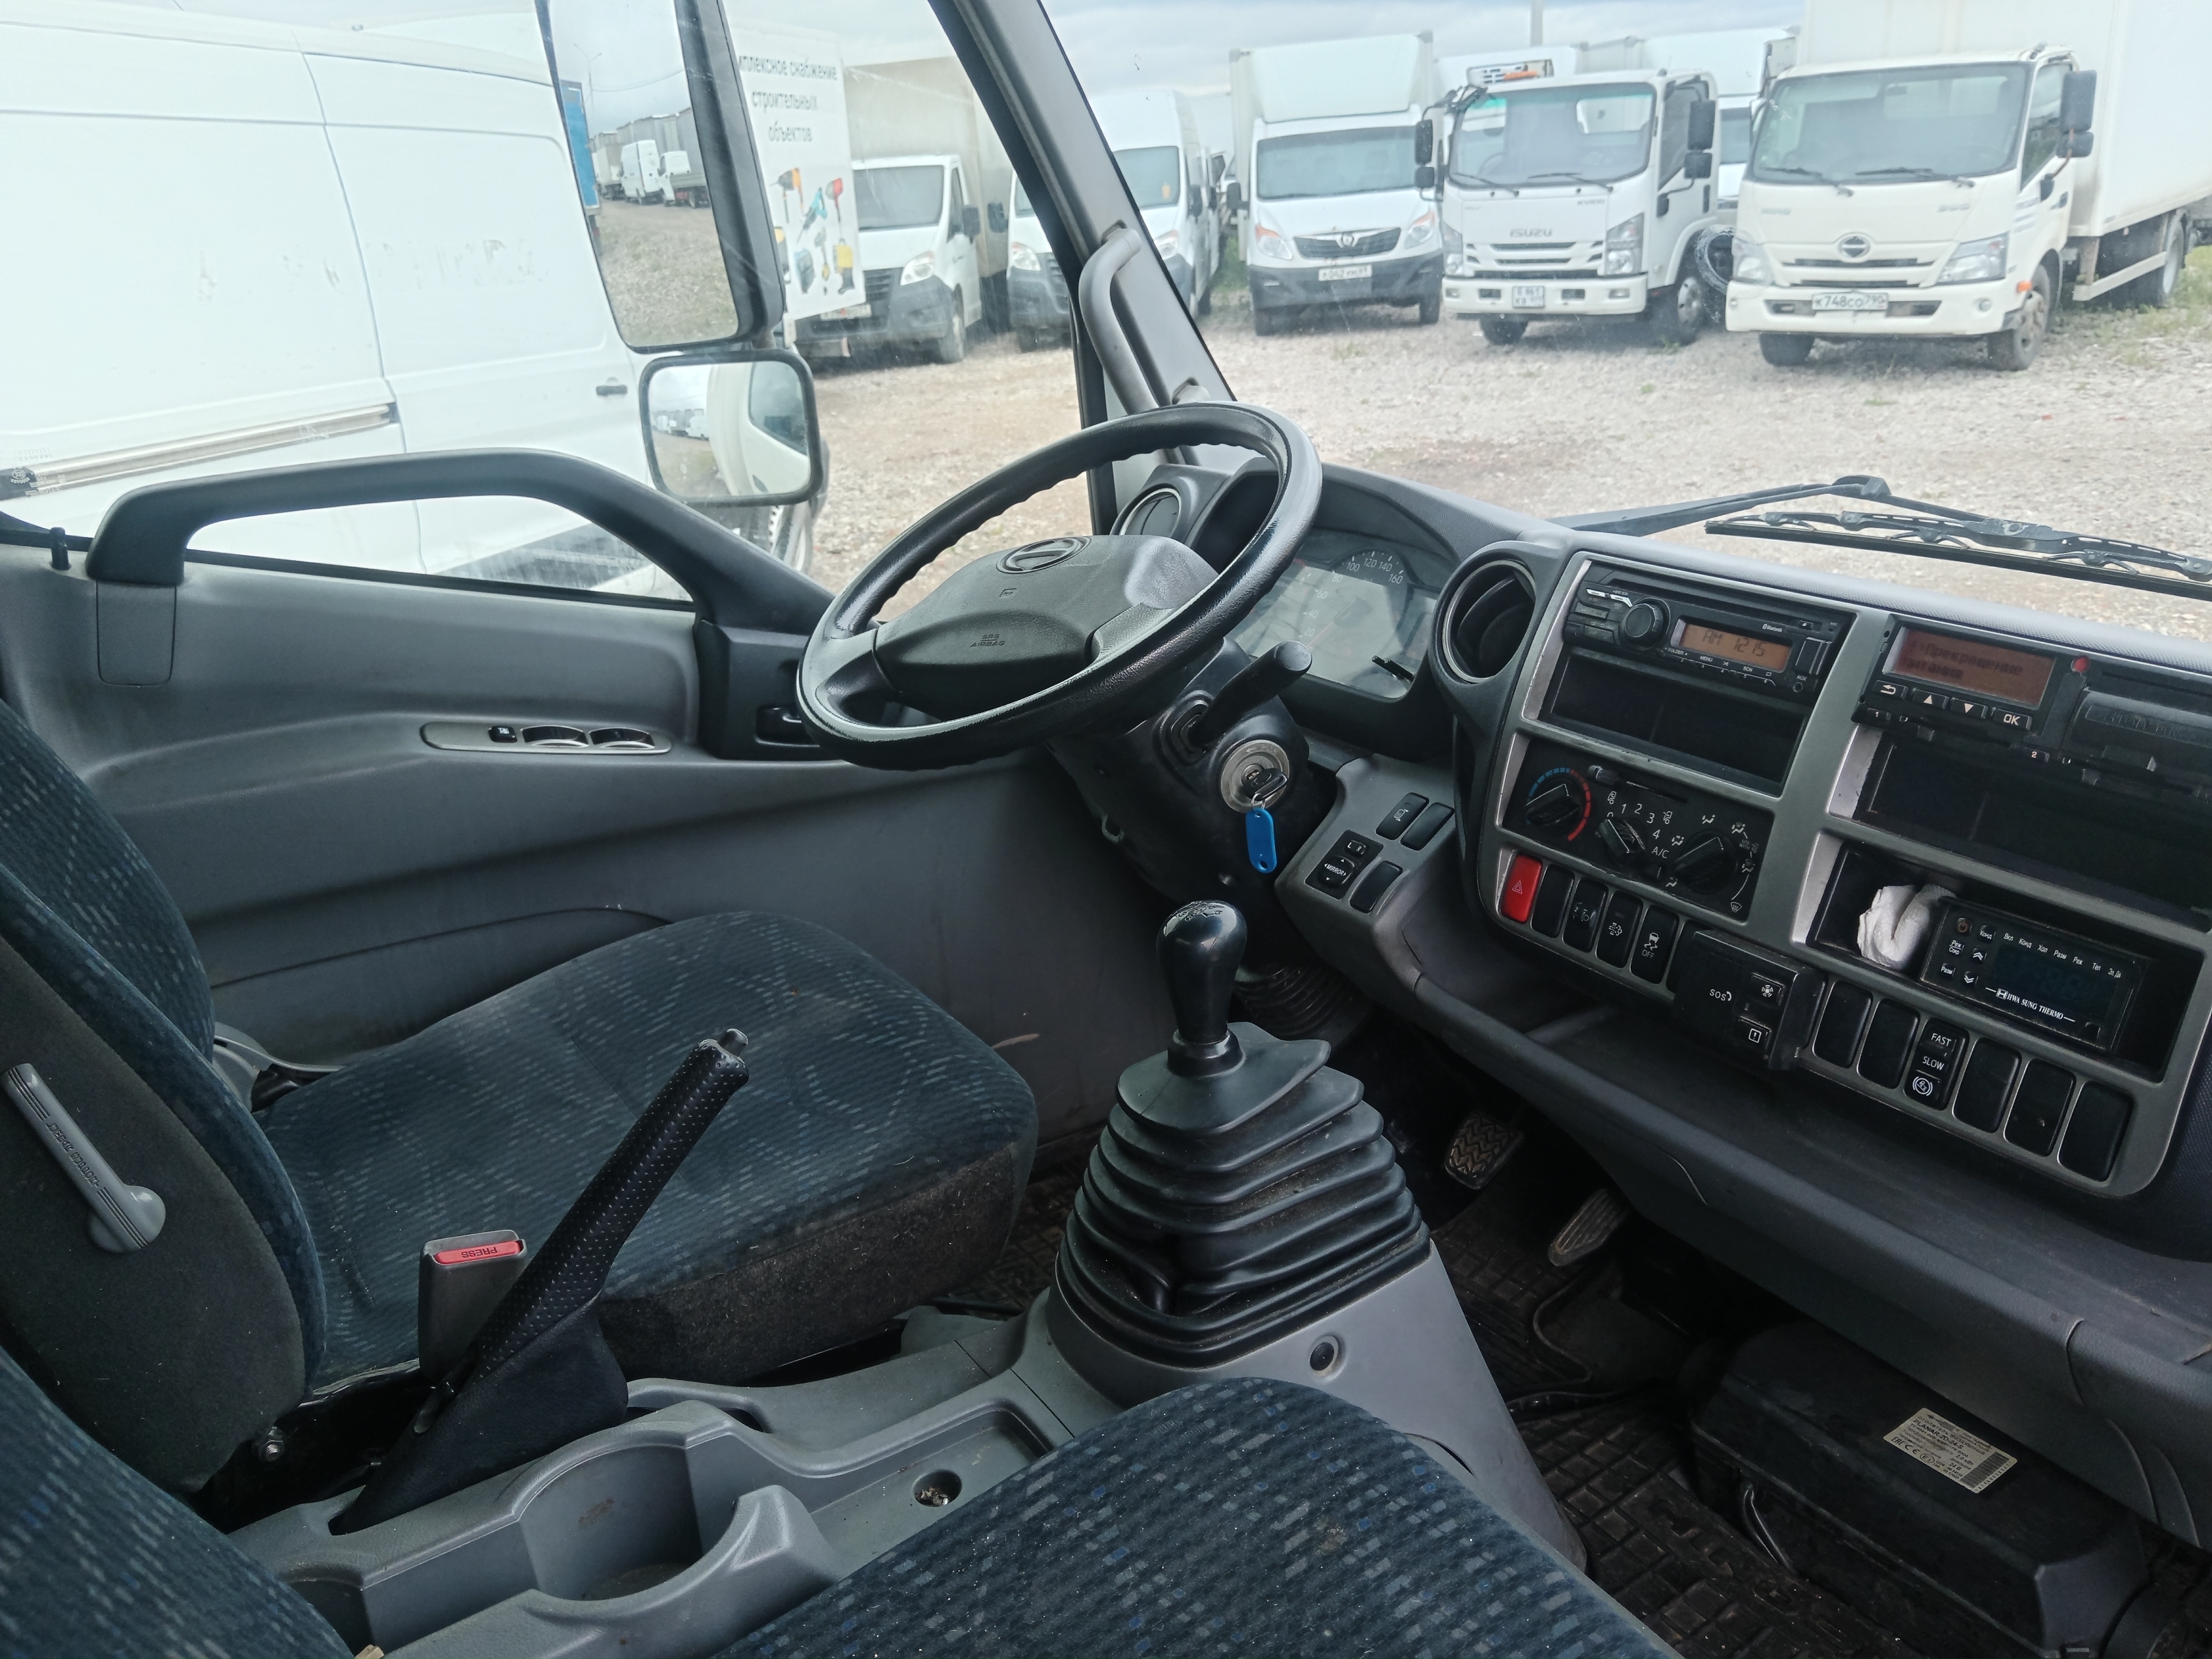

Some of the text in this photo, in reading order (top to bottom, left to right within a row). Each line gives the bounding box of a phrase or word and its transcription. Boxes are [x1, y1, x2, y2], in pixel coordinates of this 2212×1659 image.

[789, 58, 837, 80] снабжение
[752, 92, 818, 113] строительных
[768, 121, 813, 142] объектов
[1510, 229, 1552, 238] ISUZU
[1347, 562, 1360, 572] 100
[1363, 558, 1377, 568] 120
[1379, 562, 1392, 571] 140
[1332, 573, 1343, 583] 80
[1389, 574, 1403, 584] 160
[1702, 629, 1723, 645] AM
[2003, 714, 2020, 726] OK
[1622, 804, 1627, 813] 1
[1635, 803, 1642, 814] 2
[1647, 813, 1655, 823] 3
[1653, 830, 1661, 839] 4
[1652, 846, 1669, 859] A/C
[1326, 864, 1344, 875] MIRROR
[1980, 930, 1992, 940] Конд
[1951, 940, 1962, 948] Реж
[2004, 933, 2014, 941] Вкл
[2018, 938, 2032, 948] Конд
[2054, 950, 2067, 959] Разм
[2073, 956, 2083, 965] Реж
[1642, 949, 1655, 959] OFF
[1940, 965, 1953, 975] Разм
[1709, 989, 1726, 1001] SOS
[2007, 993, 2020, 1003] HWA
[2021, 999, 2038, 1010] SUNG
[2039, 1005, 2064, 1020] THERMO
[1931, 1033, 1952, 1047] FAST
[1922, 1056, 1944, 1070] SLOW
[461, 1247, 498, 1258] PRESS
